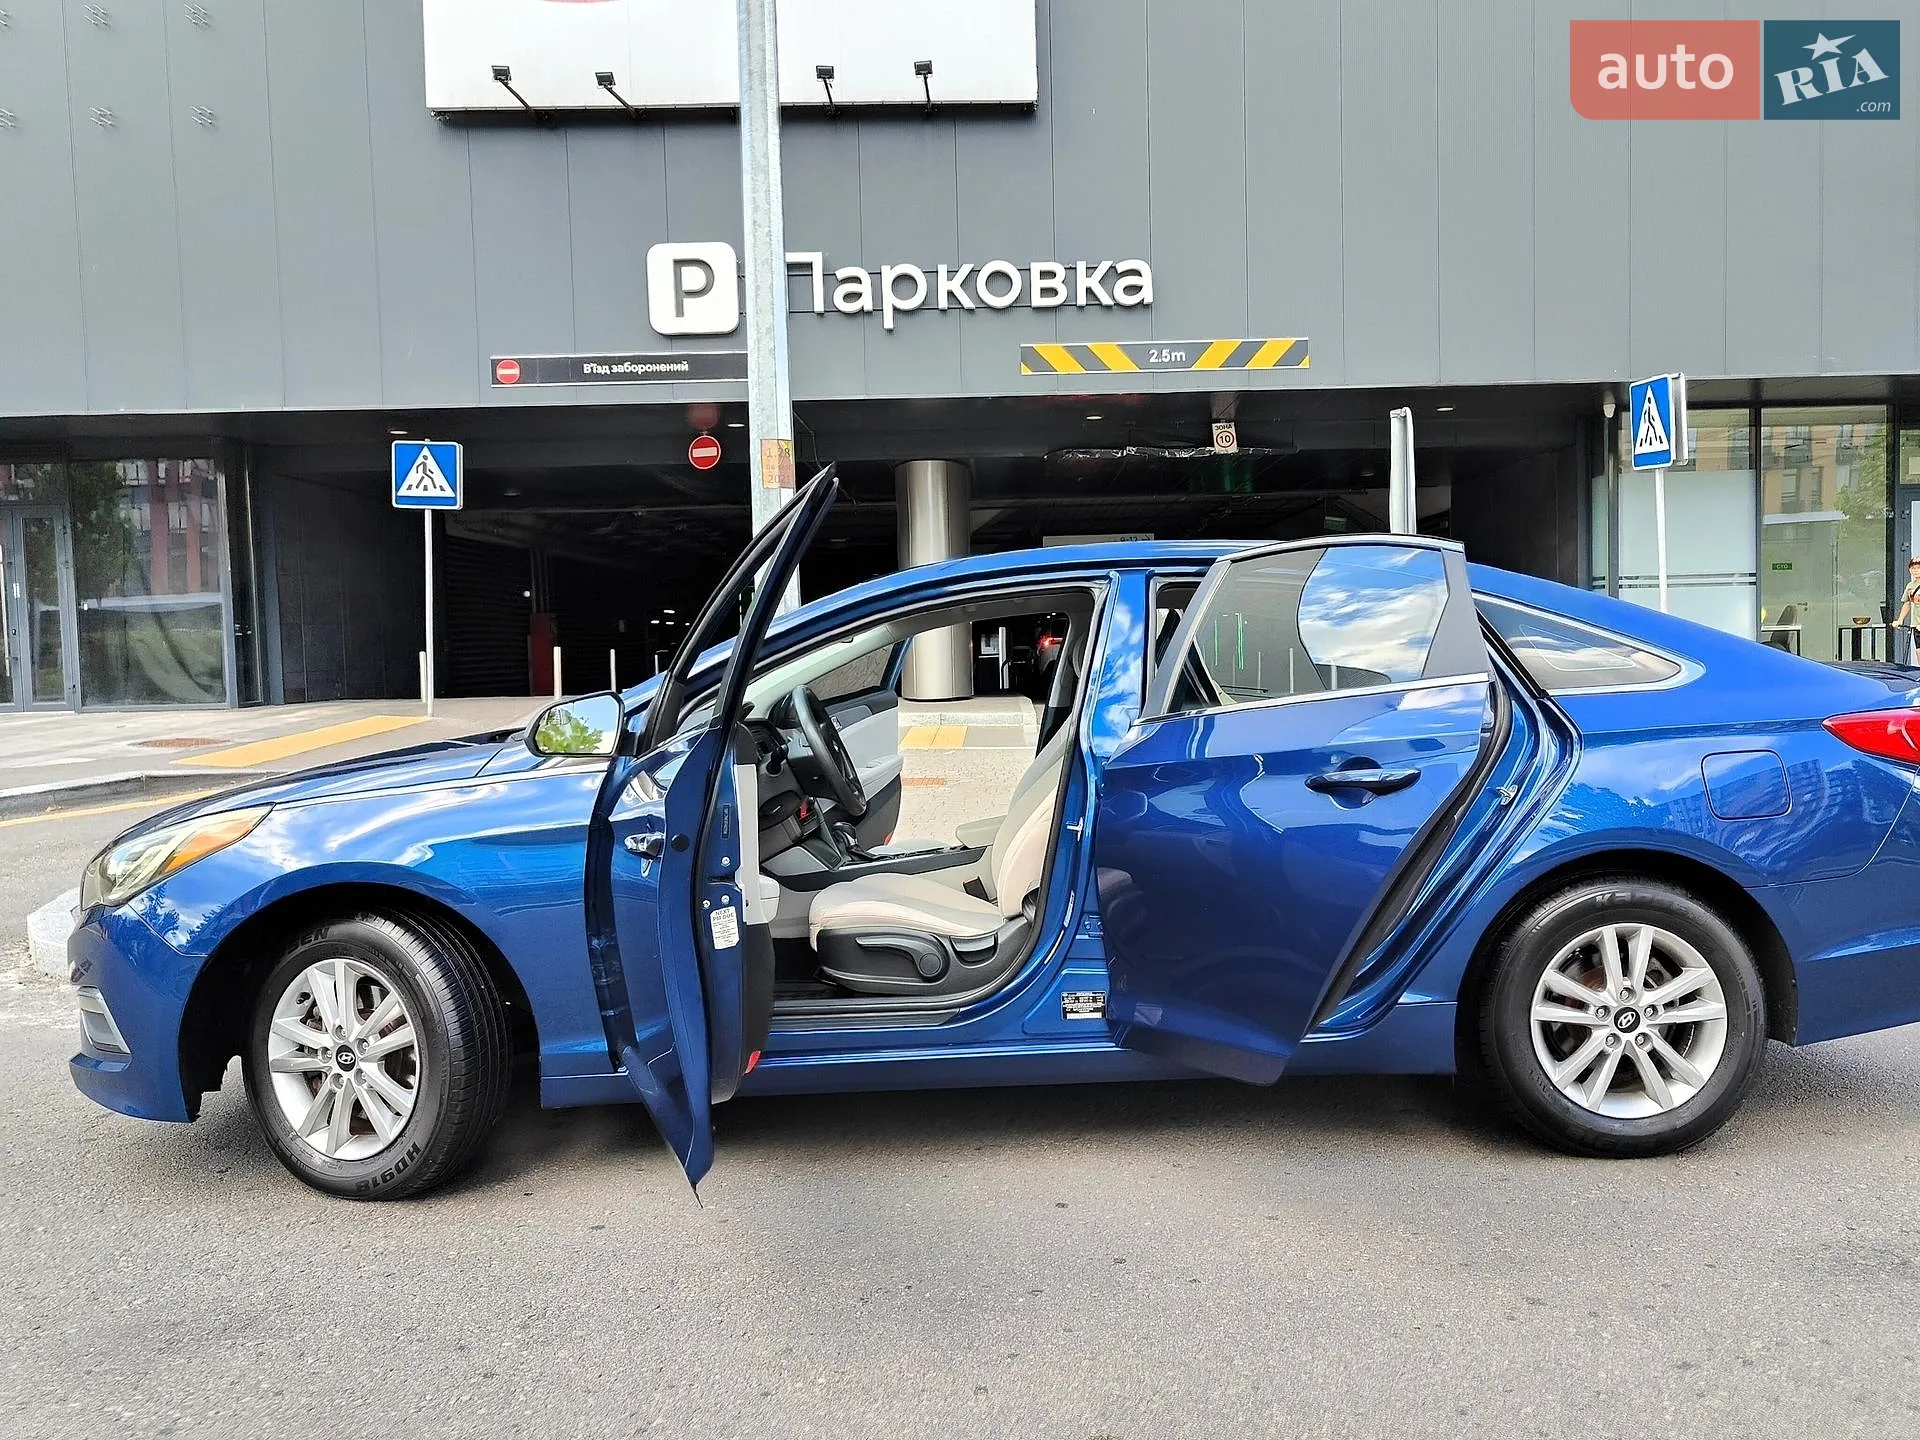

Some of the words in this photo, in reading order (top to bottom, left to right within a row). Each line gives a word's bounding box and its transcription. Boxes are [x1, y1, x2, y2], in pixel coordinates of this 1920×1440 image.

[672, 258, 715, 319] P
[785, 251, 1154, 331] Парковка
[611, 361, 689, 375] заборонений
[1149, 349, 1186, 363] 2.5m
[1219, 434, 1231, 444] 10
[355, 1141, 422, 1193] HD918
